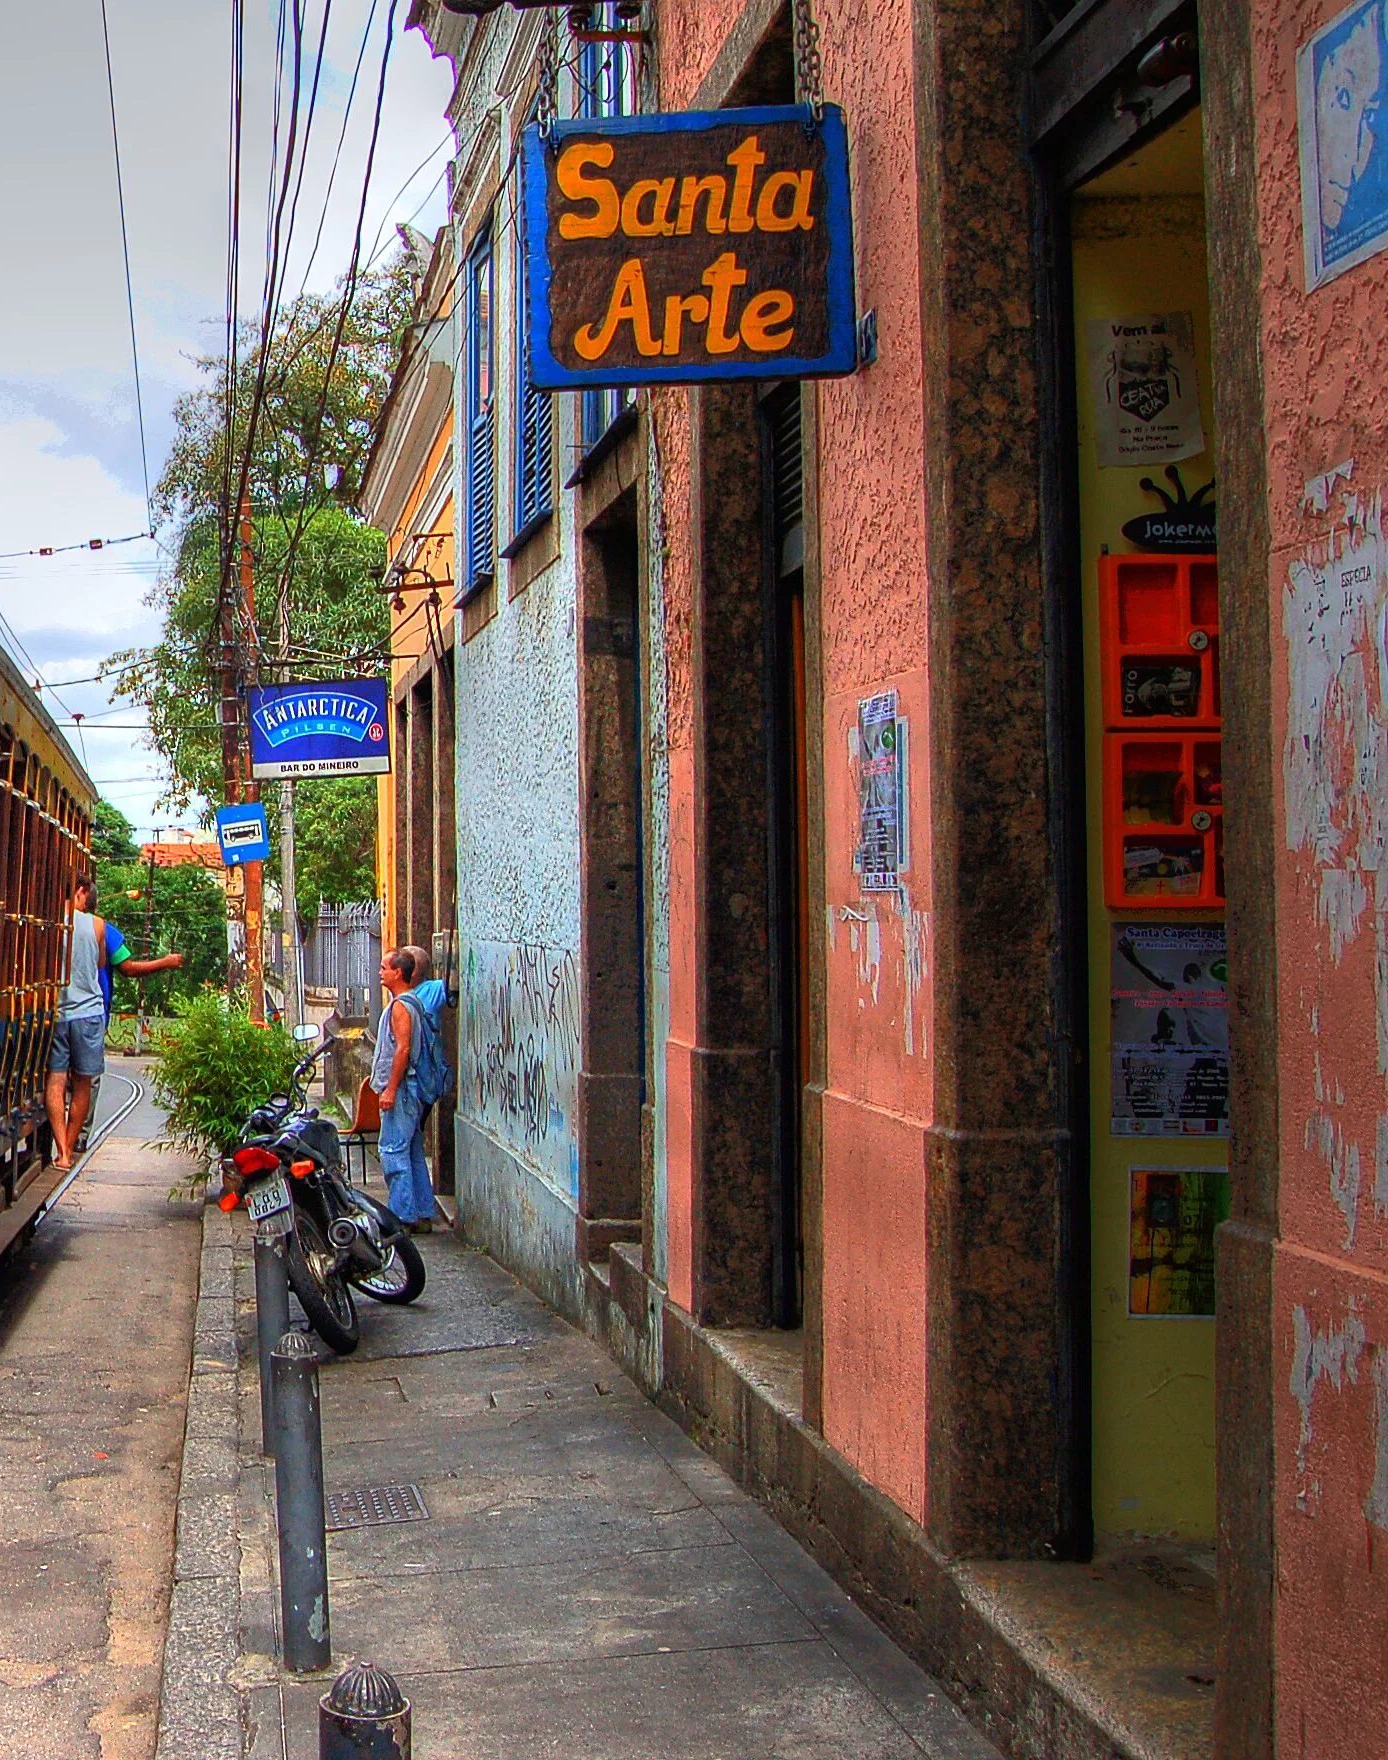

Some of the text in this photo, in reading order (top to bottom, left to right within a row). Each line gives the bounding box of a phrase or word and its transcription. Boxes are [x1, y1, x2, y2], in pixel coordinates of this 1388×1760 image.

[556, 135, 815, 240] Santa
[573, 252, 795, 361] Arte
[262, 698, 369, 731] ANTARCTICA
[281, 722, 352, 739] PILSEN
[280, 760, 359, 773] BAR DO MINEIRO
[1126, 927, 1160, 938] Santa
